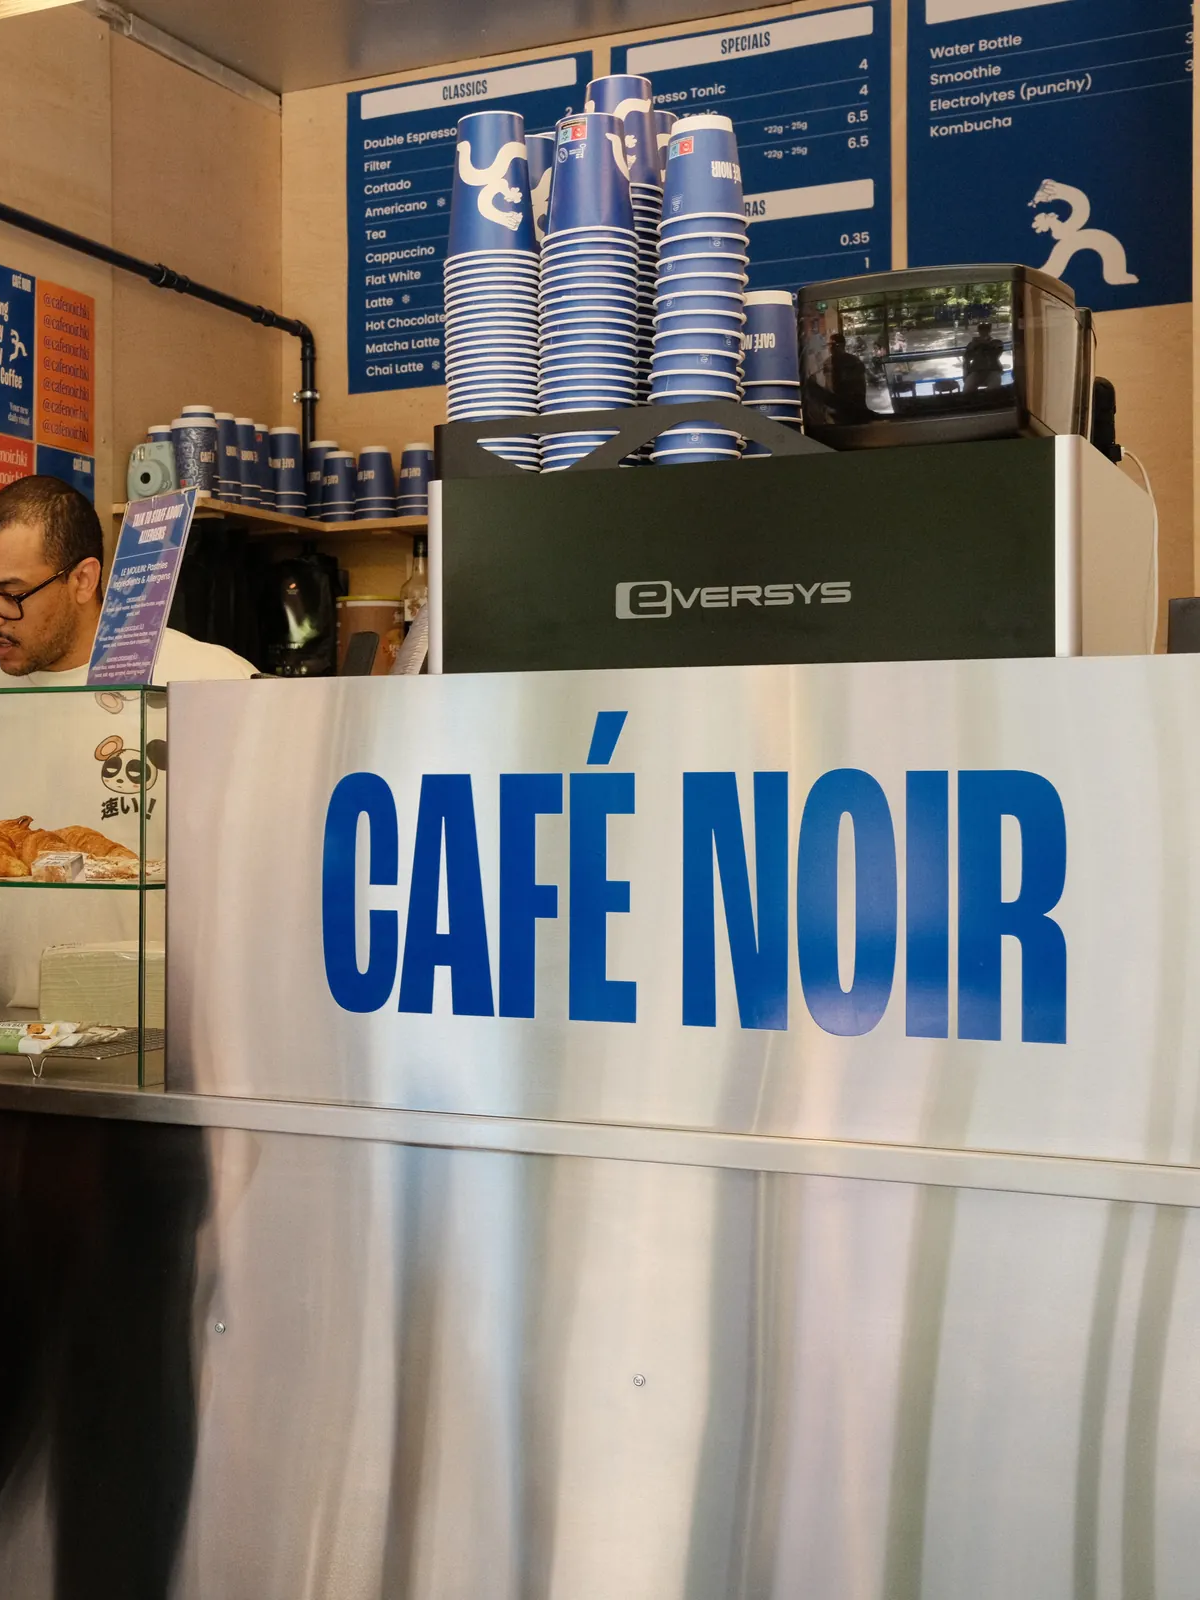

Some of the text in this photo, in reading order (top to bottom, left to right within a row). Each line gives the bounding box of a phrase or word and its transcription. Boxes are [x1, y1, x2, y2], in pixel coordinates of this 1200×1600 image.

[721, 31, 771, 55] SPECIALS
[930, 34, 1022, 60] Water Bottle
[859, 59, 869, 70] 4
[930, 64, 1002, 86] Smoothie
[442, 80, 488, 100] CLASSICS
[690, 84, 726, 98] Tonic
[859, 84, 869, 96] 4
[930, 73, 1092, 112] Electrolytes (punchy)
[847, 110, 869, 124] 6.5
[930, 116, 1012, 138] Kombucha
[364, 126, 458, 150] Double Espresso
[848, 136, 869, 149] 6.5
[364, 160, 392, 173] Filter
[711, 160, 731, 178] NOIR
[364, 179, 411, 195] Cortado
[365, 200, 427, 218] Americano
[365, 229, 386, 241] Tea
[840, 232, 870, 246] 0.35
[365, 245, 435, 266] Cappuccino
[864, 257, 870, 269] 1
[365, 269, 421, 286] Flat White
[365, 296, 394, 309] Latte
[365, 312, 446, 332] Hot Chocolate
[366, 337, 440, 355] Matcha Latte
[753, 332, 776, 353] CAFÉ
[366, 362, 424, 377] Chai Latte
[165, 503, 184, 521] ABOUT
[146, 572, 171, 584] Allergens
[322, 711, 1068, 1045] CAFÉ NOIR
